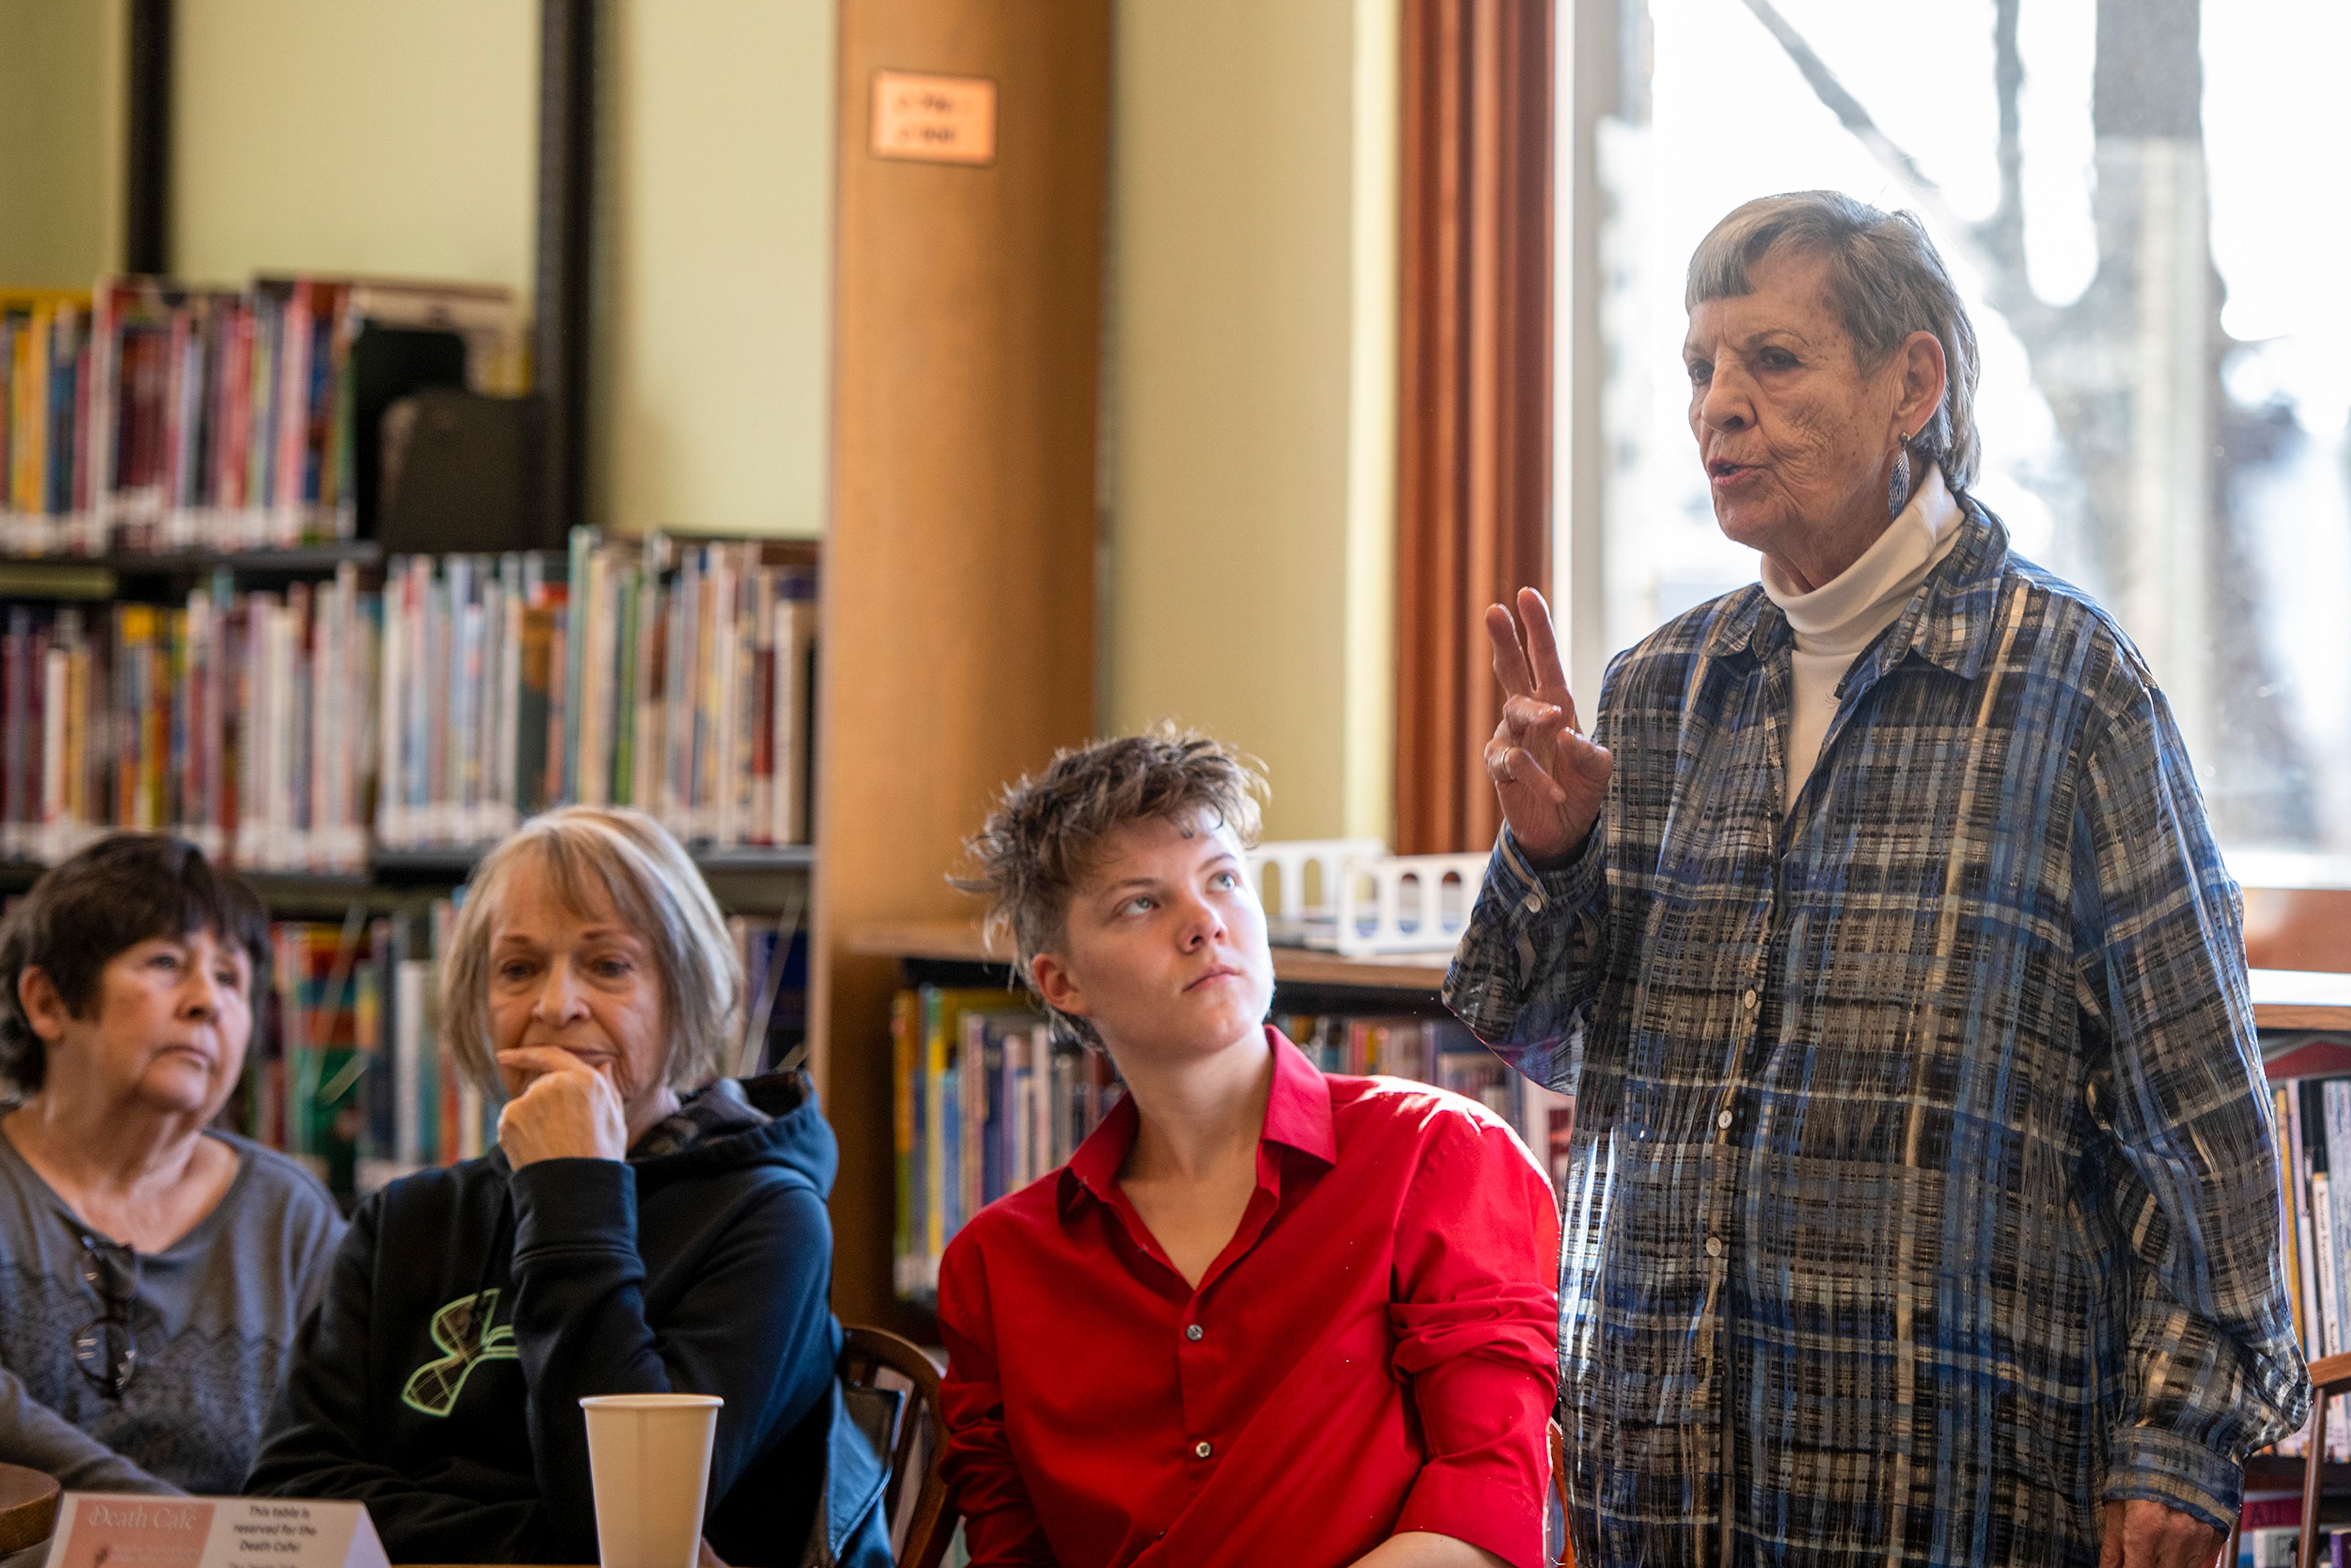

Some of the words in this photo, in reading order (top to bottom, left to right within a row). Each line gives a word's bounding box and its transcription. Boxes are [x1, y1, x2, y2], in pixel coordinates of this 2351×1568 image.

[88, 1504, 148, 1528] Death
[250, 1506, 269, 1517] This
[272, 1507, 299, 1518] table
[301, 1508, 310, 1519] is
[233, 1524, 279, 1535] reserved
[282, 1525, 296, 1536] for
[299, 1526, 317, 1537] the
[239, 1540, 271, 1551] Death
